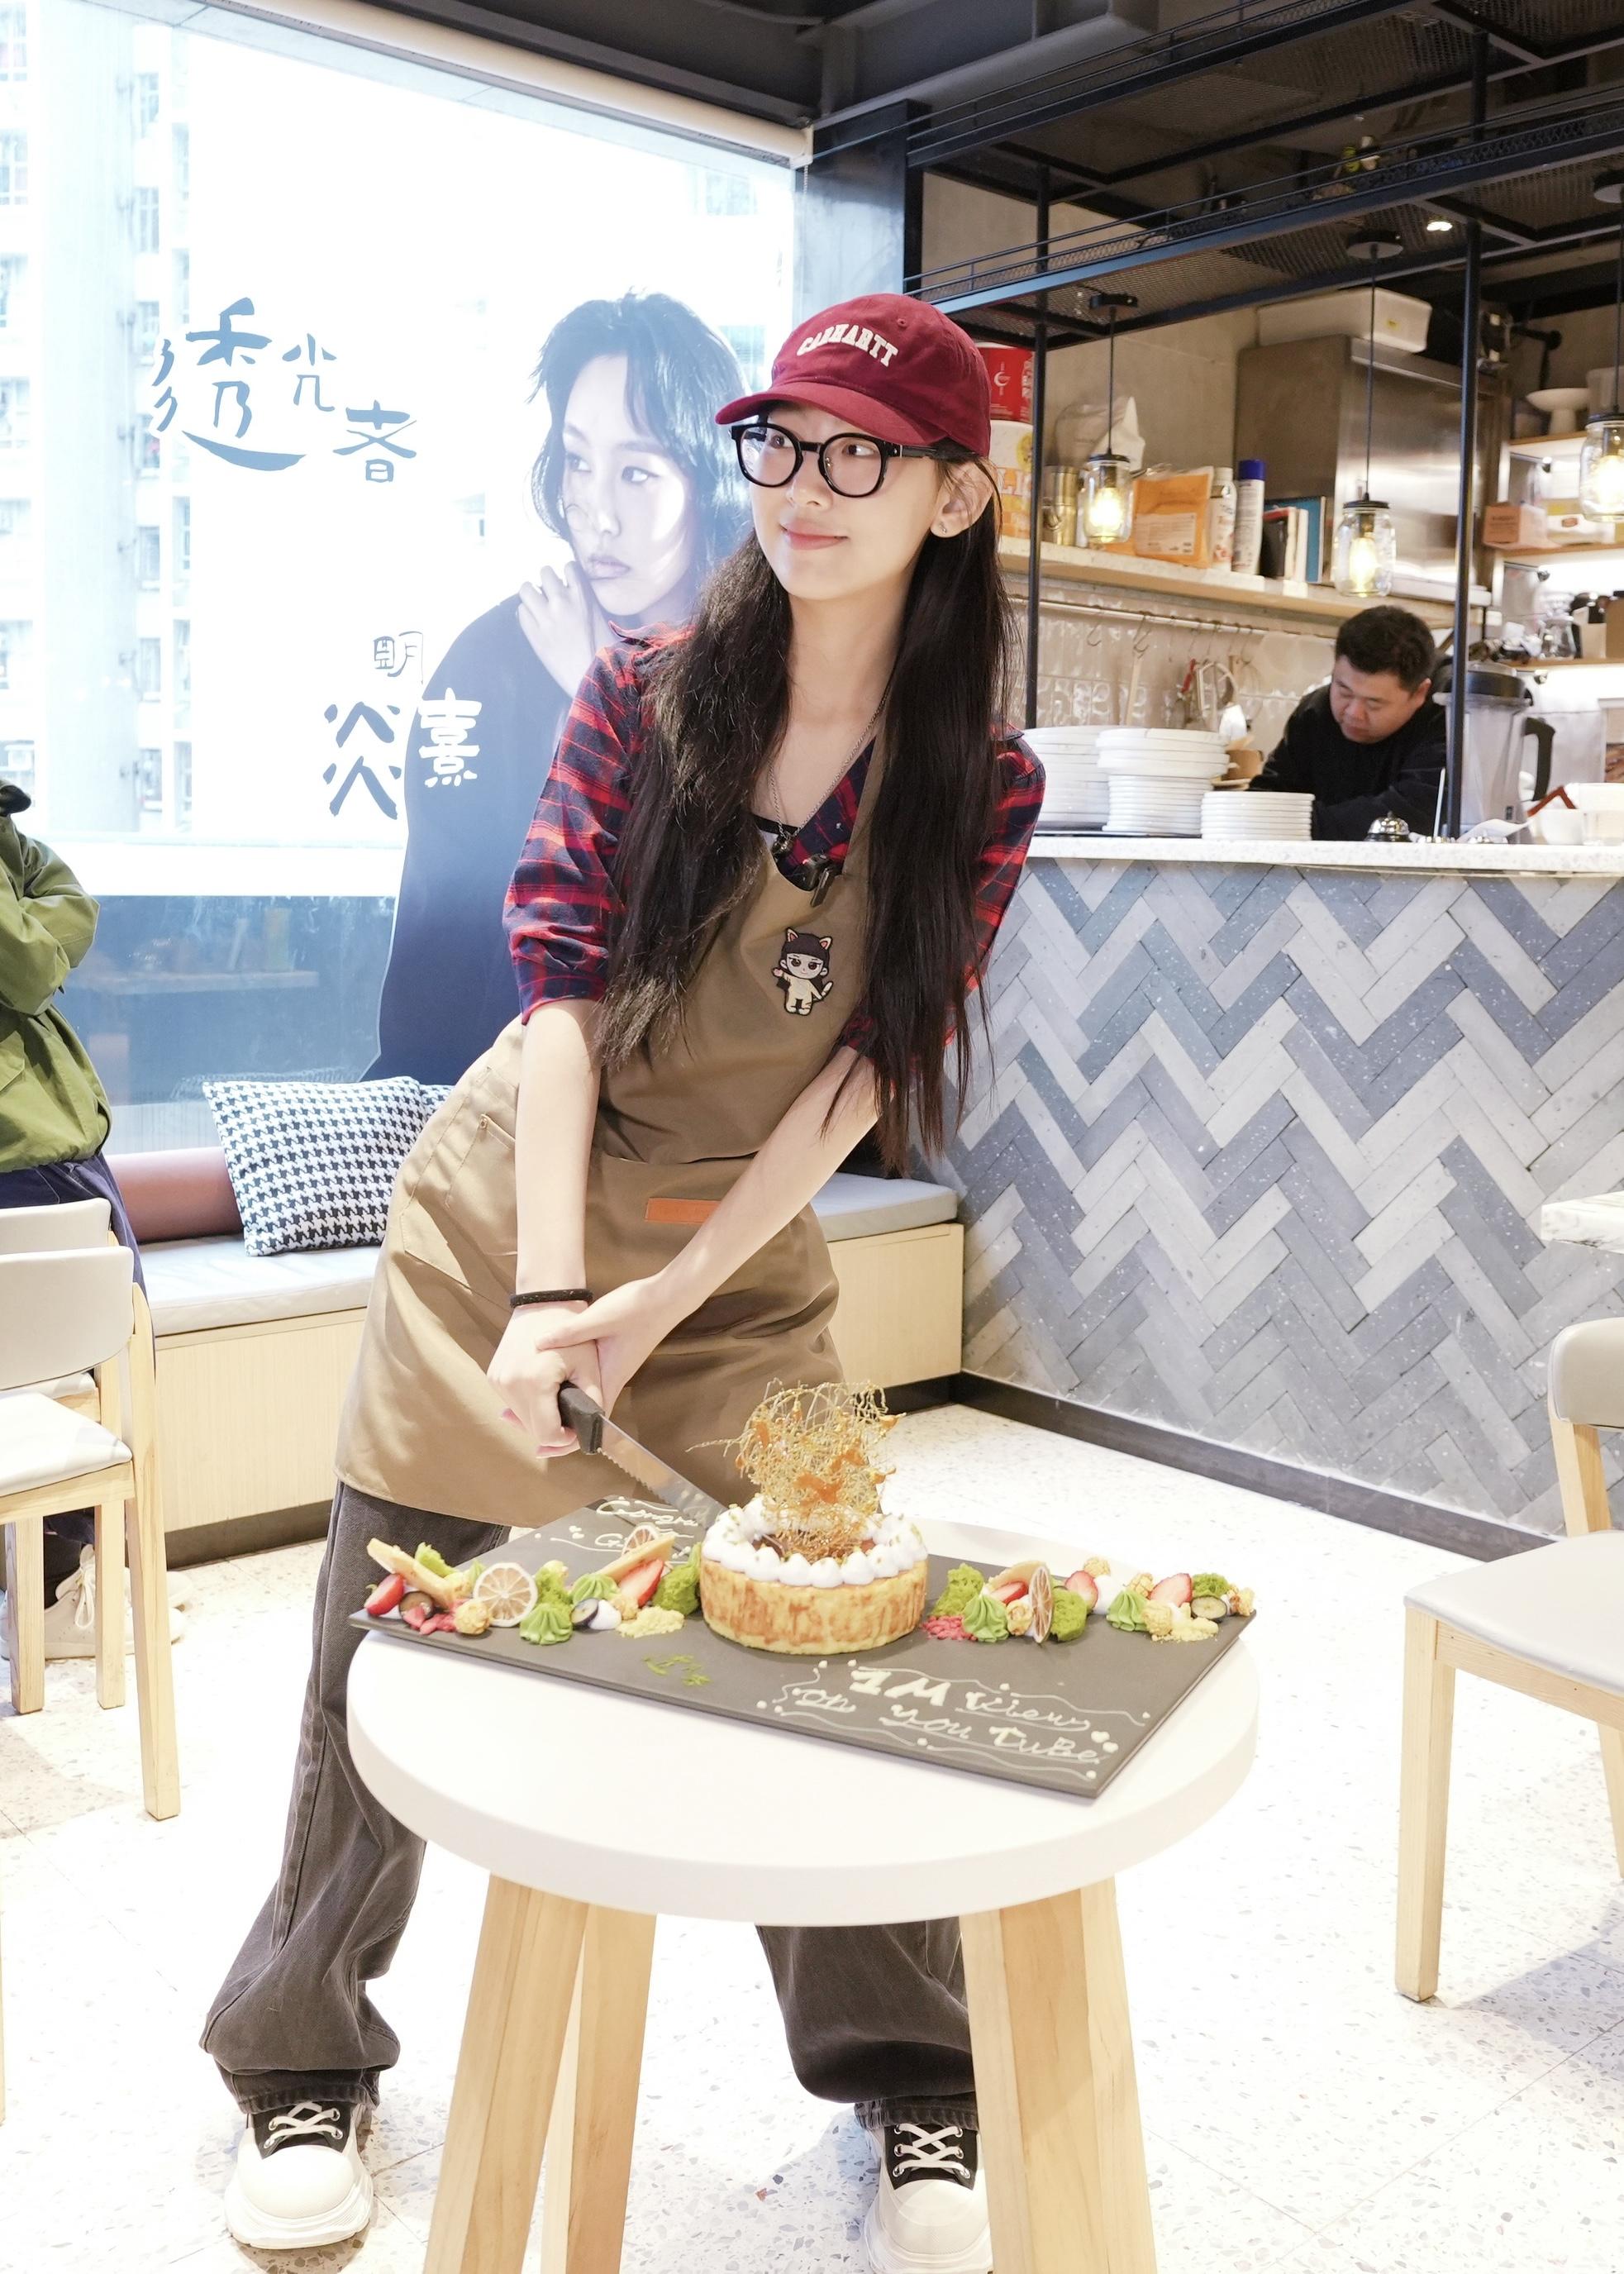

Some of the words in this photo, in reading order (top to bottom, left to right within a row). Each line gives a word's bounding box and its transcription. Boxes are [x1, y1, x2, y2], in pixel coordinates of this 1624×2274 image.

[151, 297, 417, 484] 透光者
[797, 323, 898, 367] CARHARTT
